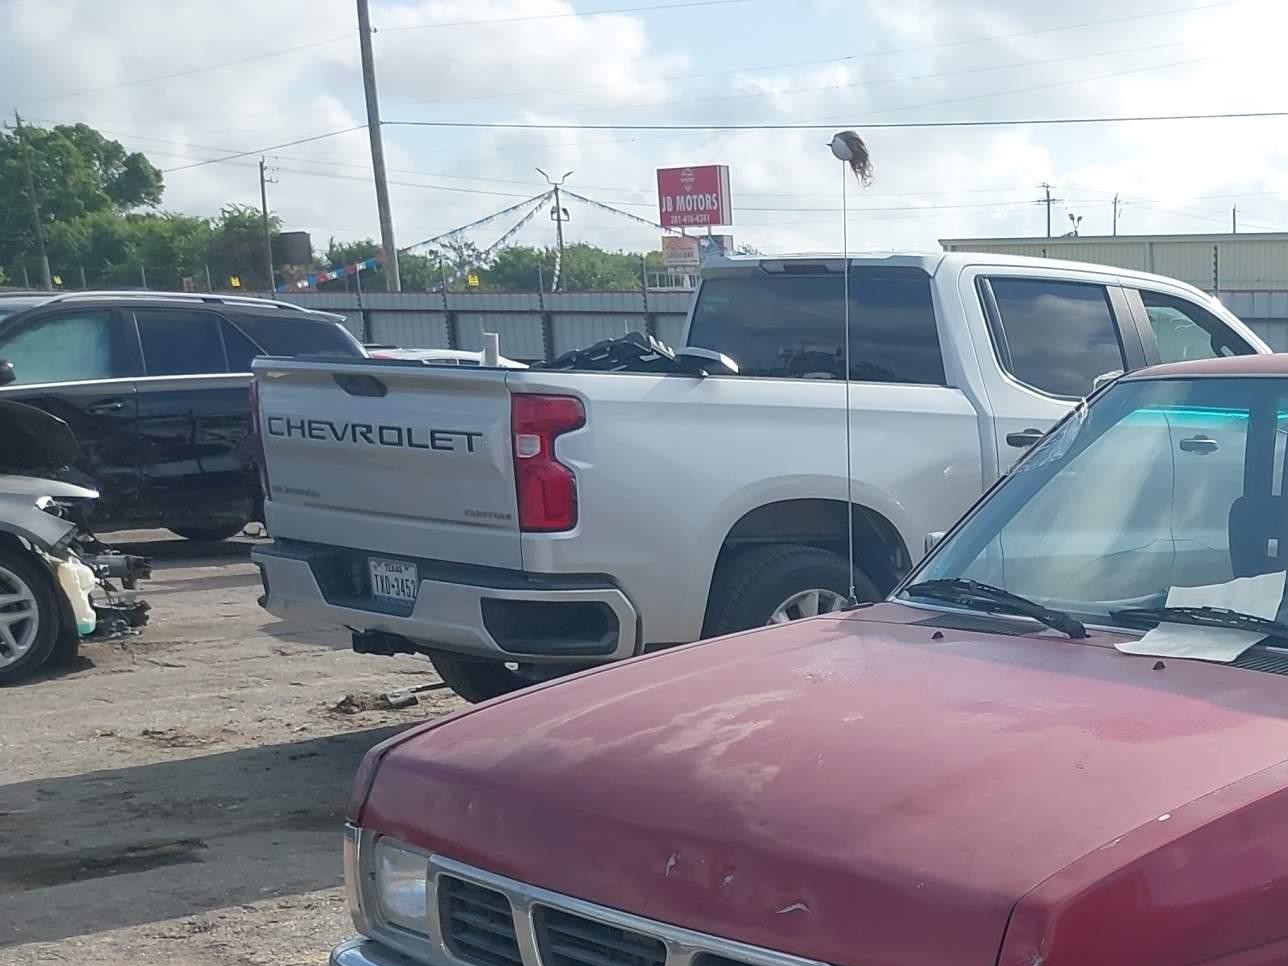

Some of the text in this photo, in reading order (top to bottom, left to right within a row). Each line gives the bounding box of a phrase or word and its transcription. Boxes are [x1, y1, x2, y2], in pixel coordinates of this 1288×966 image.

[662, 193, 718, 213] JB MOTORS
[267, 416, 483, 453] CHEVROLET
